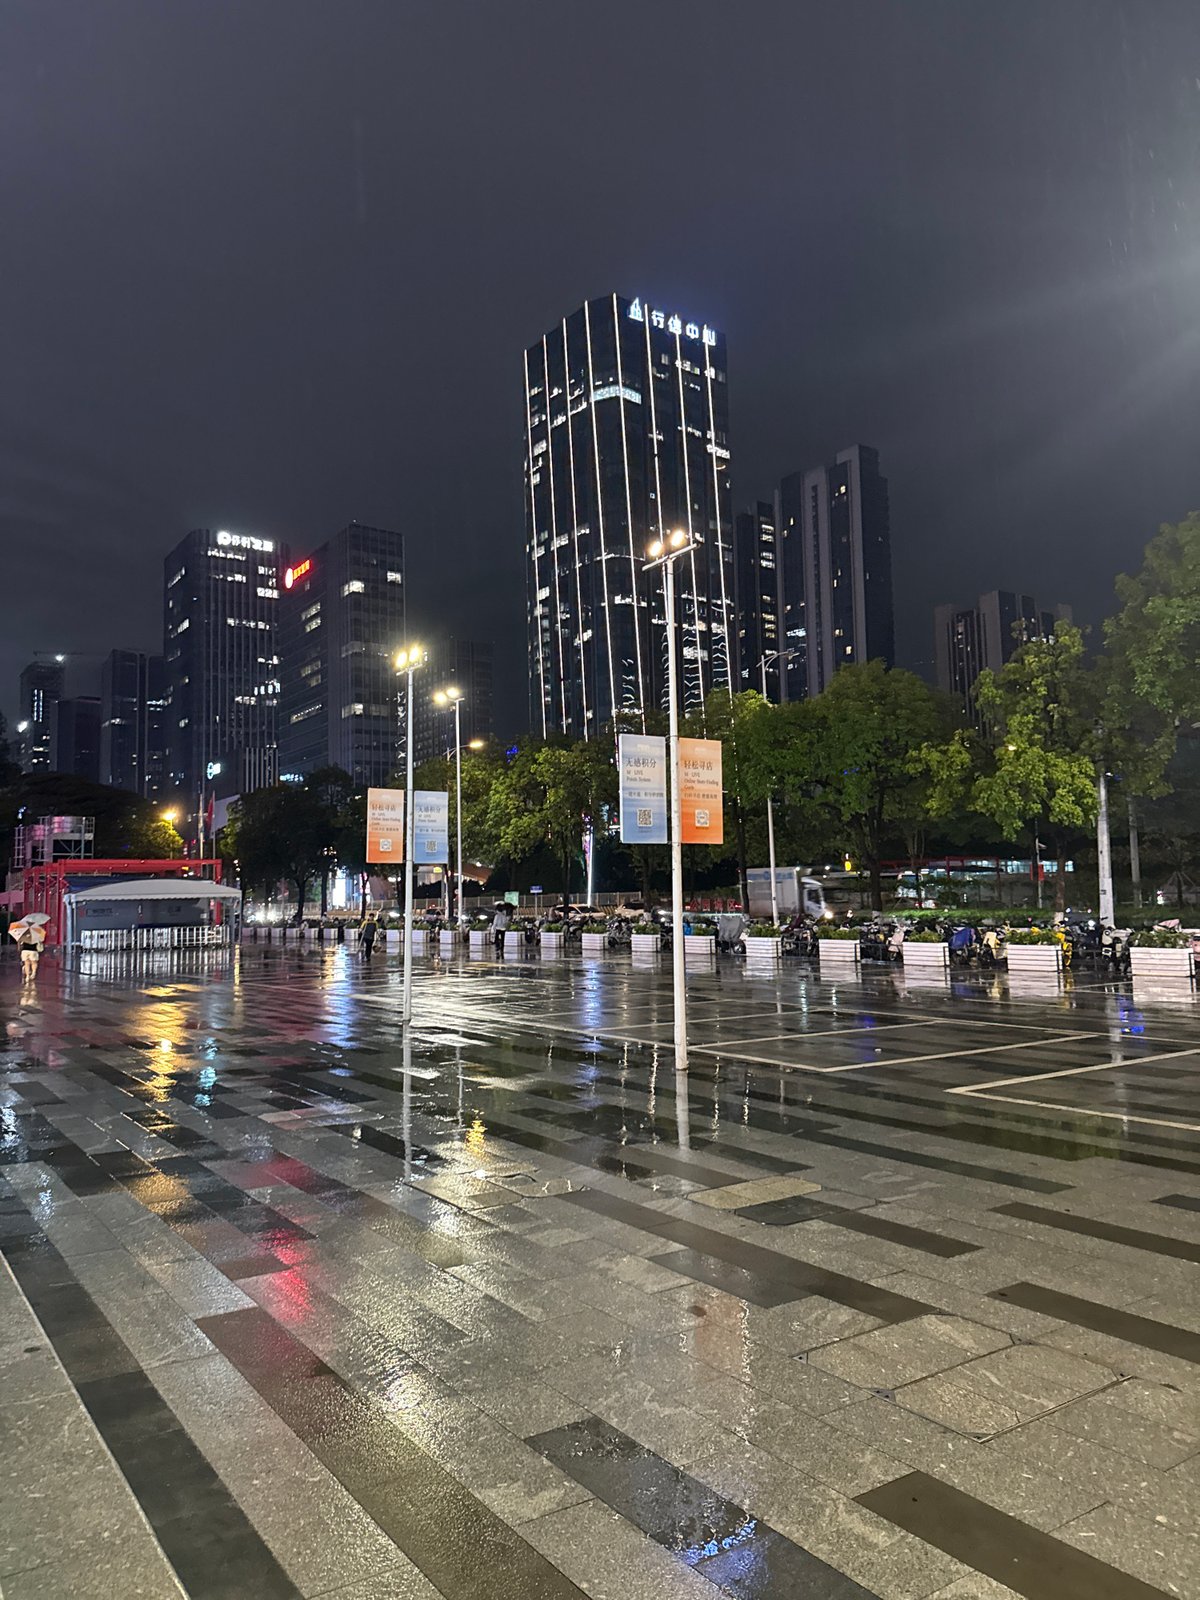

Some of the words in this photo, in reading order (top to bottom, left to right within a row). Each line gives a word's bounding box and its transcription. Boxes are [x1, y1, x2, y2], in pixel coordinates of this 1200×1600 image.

[626, 757, 657, 769] 无感积分
[684, 760, 713, 772] 轻松寻店
